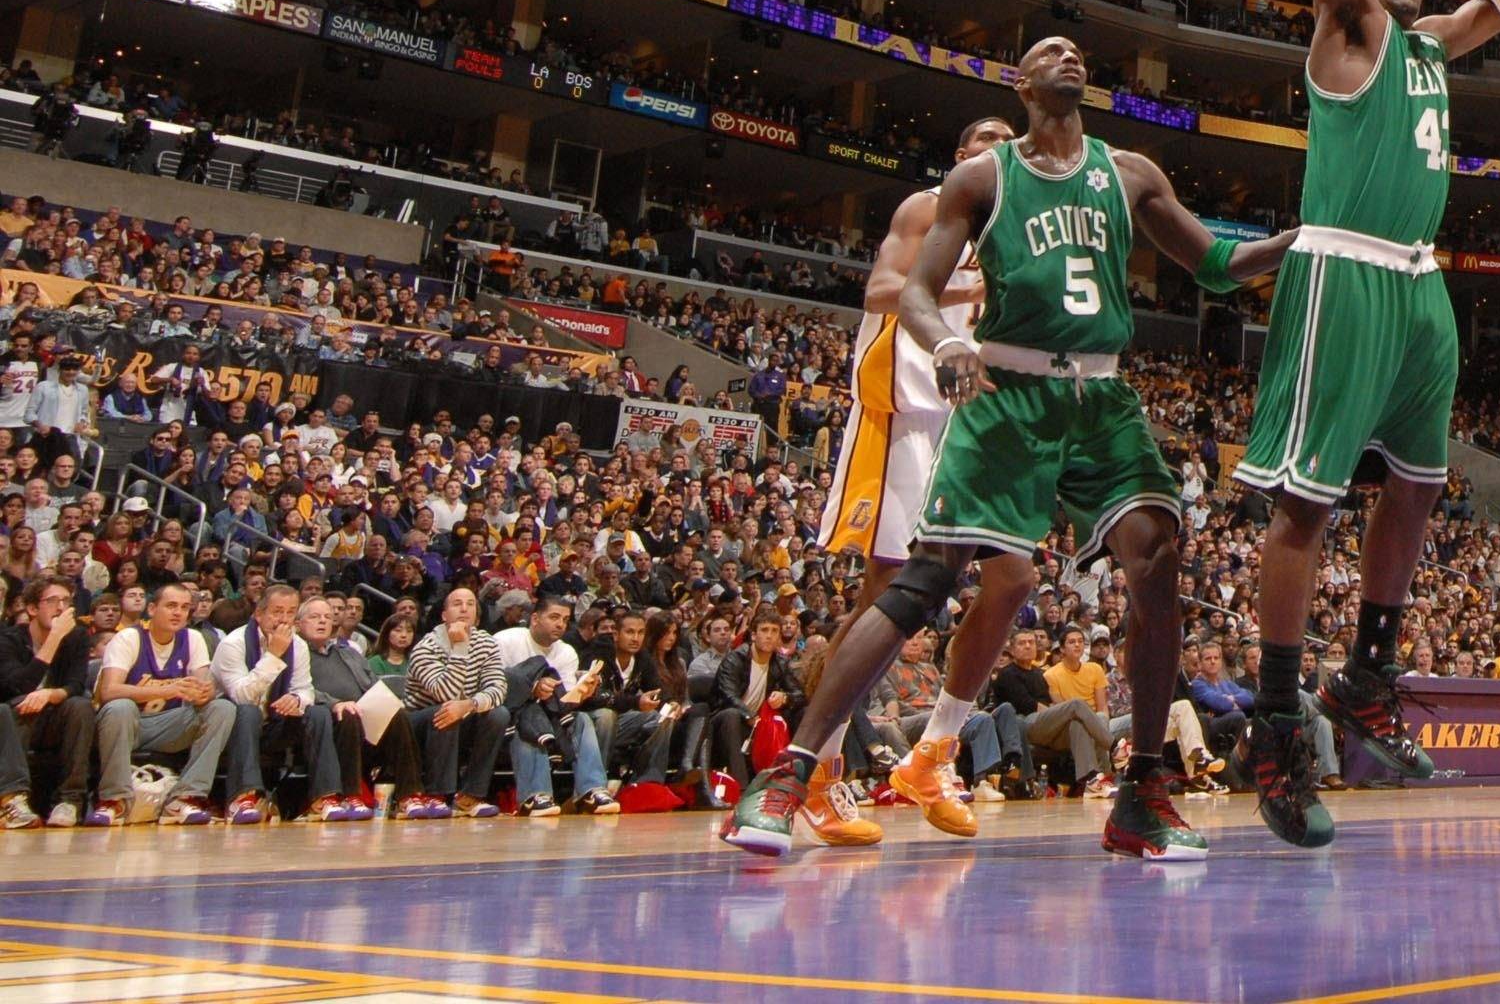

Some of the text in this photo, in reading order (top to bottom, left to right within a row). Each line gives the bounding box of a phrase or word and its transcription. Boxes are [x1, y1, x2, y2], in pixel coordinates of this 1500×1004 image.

[330, 29, 362, 44] INDIAN
[374, 39, 400, 53] BINGO
[331, 15, 437, 53] SAN MANUEL
[530, 62, 593, 88] LA BOS
[834, 17, 1113, 111] LAKES
[533, 77, 583, 98] 0 0
[640, 95, 697, 119] PEPSI
[737, 119, 796, 145] TOYOTA
[828, 143, 899, 170] SPORT CHALET
[1025, 205, 1107, 257] CELTICS
[1237, 227, 1270, 239] Express
[1063, 256, 1102, 316] 5
[288, 374, 319, 396] AM
[627, 406, 677, 419] 1330 AM
[711, 417, 737, 426] 1330
